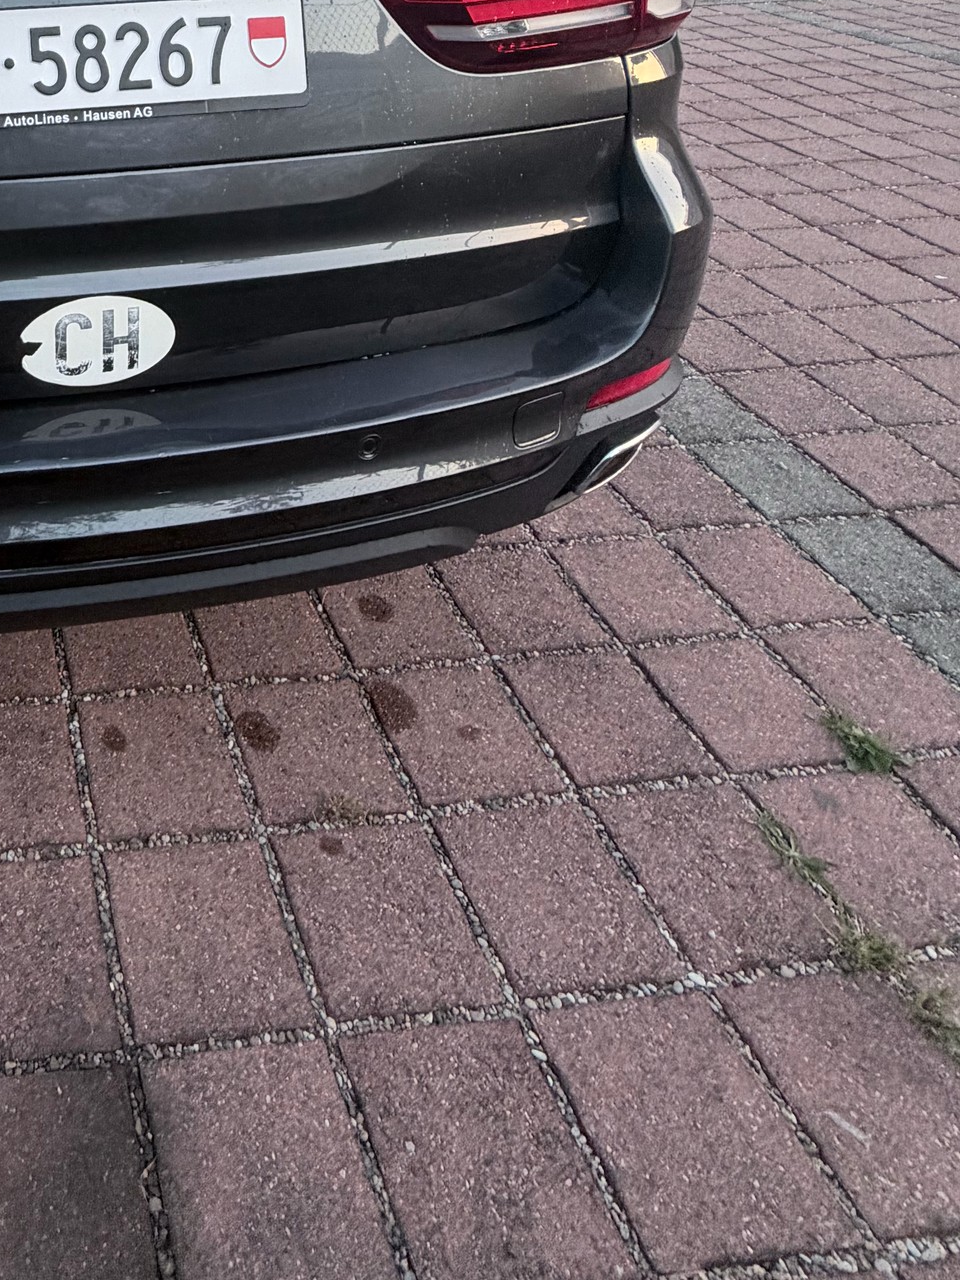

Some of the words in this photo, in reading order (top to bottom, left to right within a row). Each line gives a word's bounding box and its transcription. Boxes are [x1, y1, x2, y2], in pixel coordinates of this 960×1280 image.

[3, 113, 70, 128] AutoLines
[83, 108, 131, 122] Hausen
[133, 105, 154, 119] AG
[54, 306, 140, 377] CH
